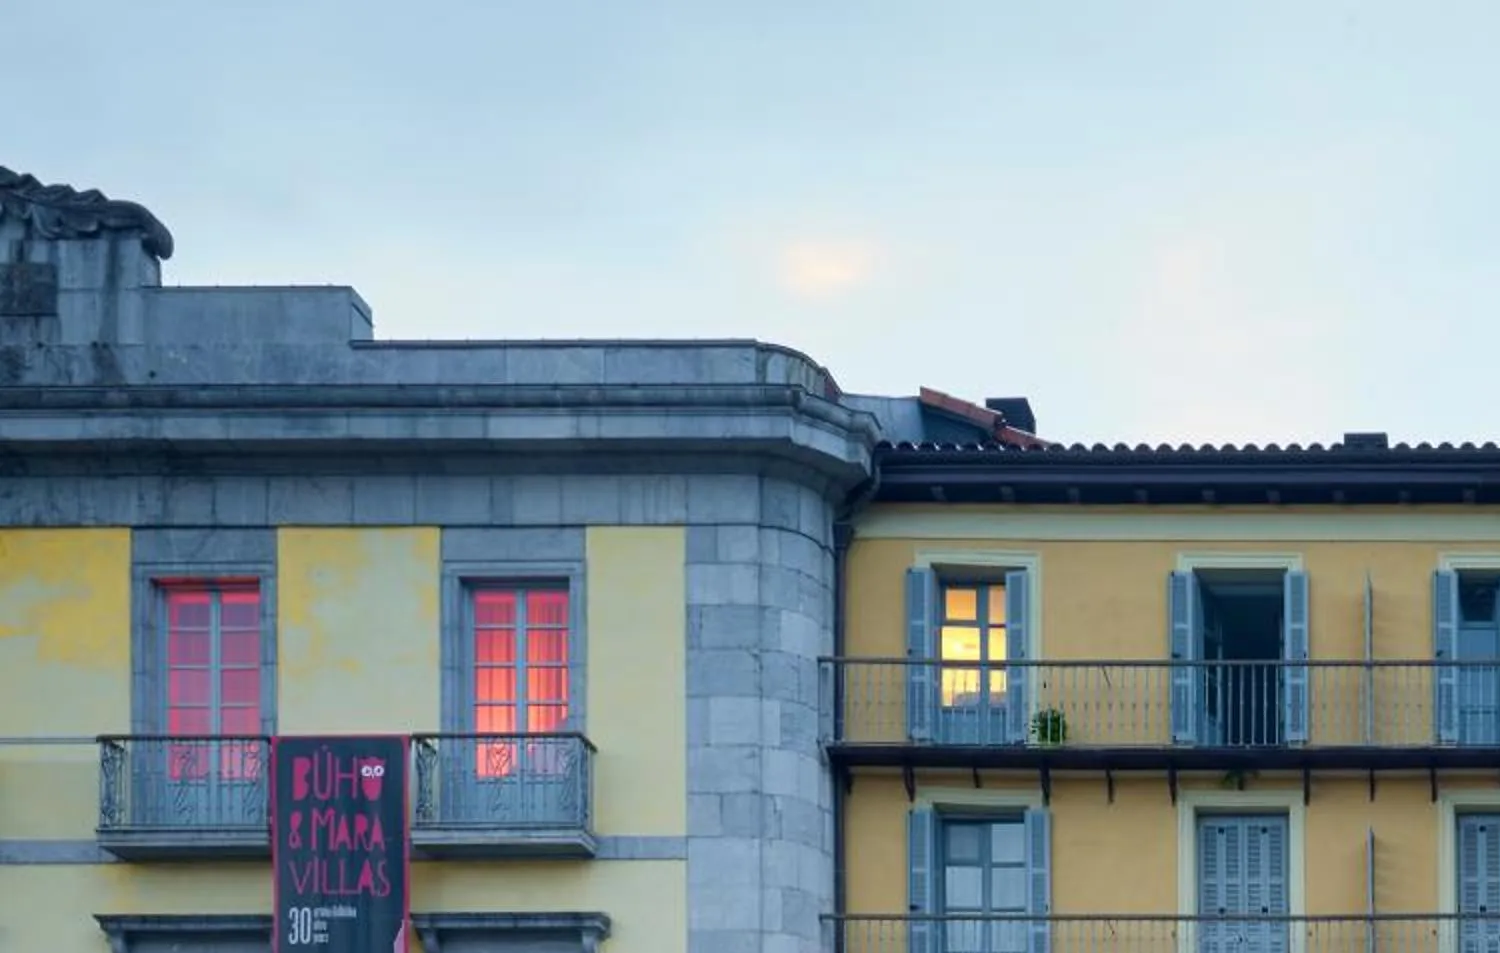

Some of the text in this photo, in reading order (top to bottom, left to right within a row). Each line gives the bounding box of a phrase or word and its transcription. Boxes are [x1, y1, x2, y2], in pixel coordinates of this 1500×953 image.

[288, 807, 386, 852] & MARA
[288, 856, 391, 898] VILLAS
[288, 906, 312, 944] 30
